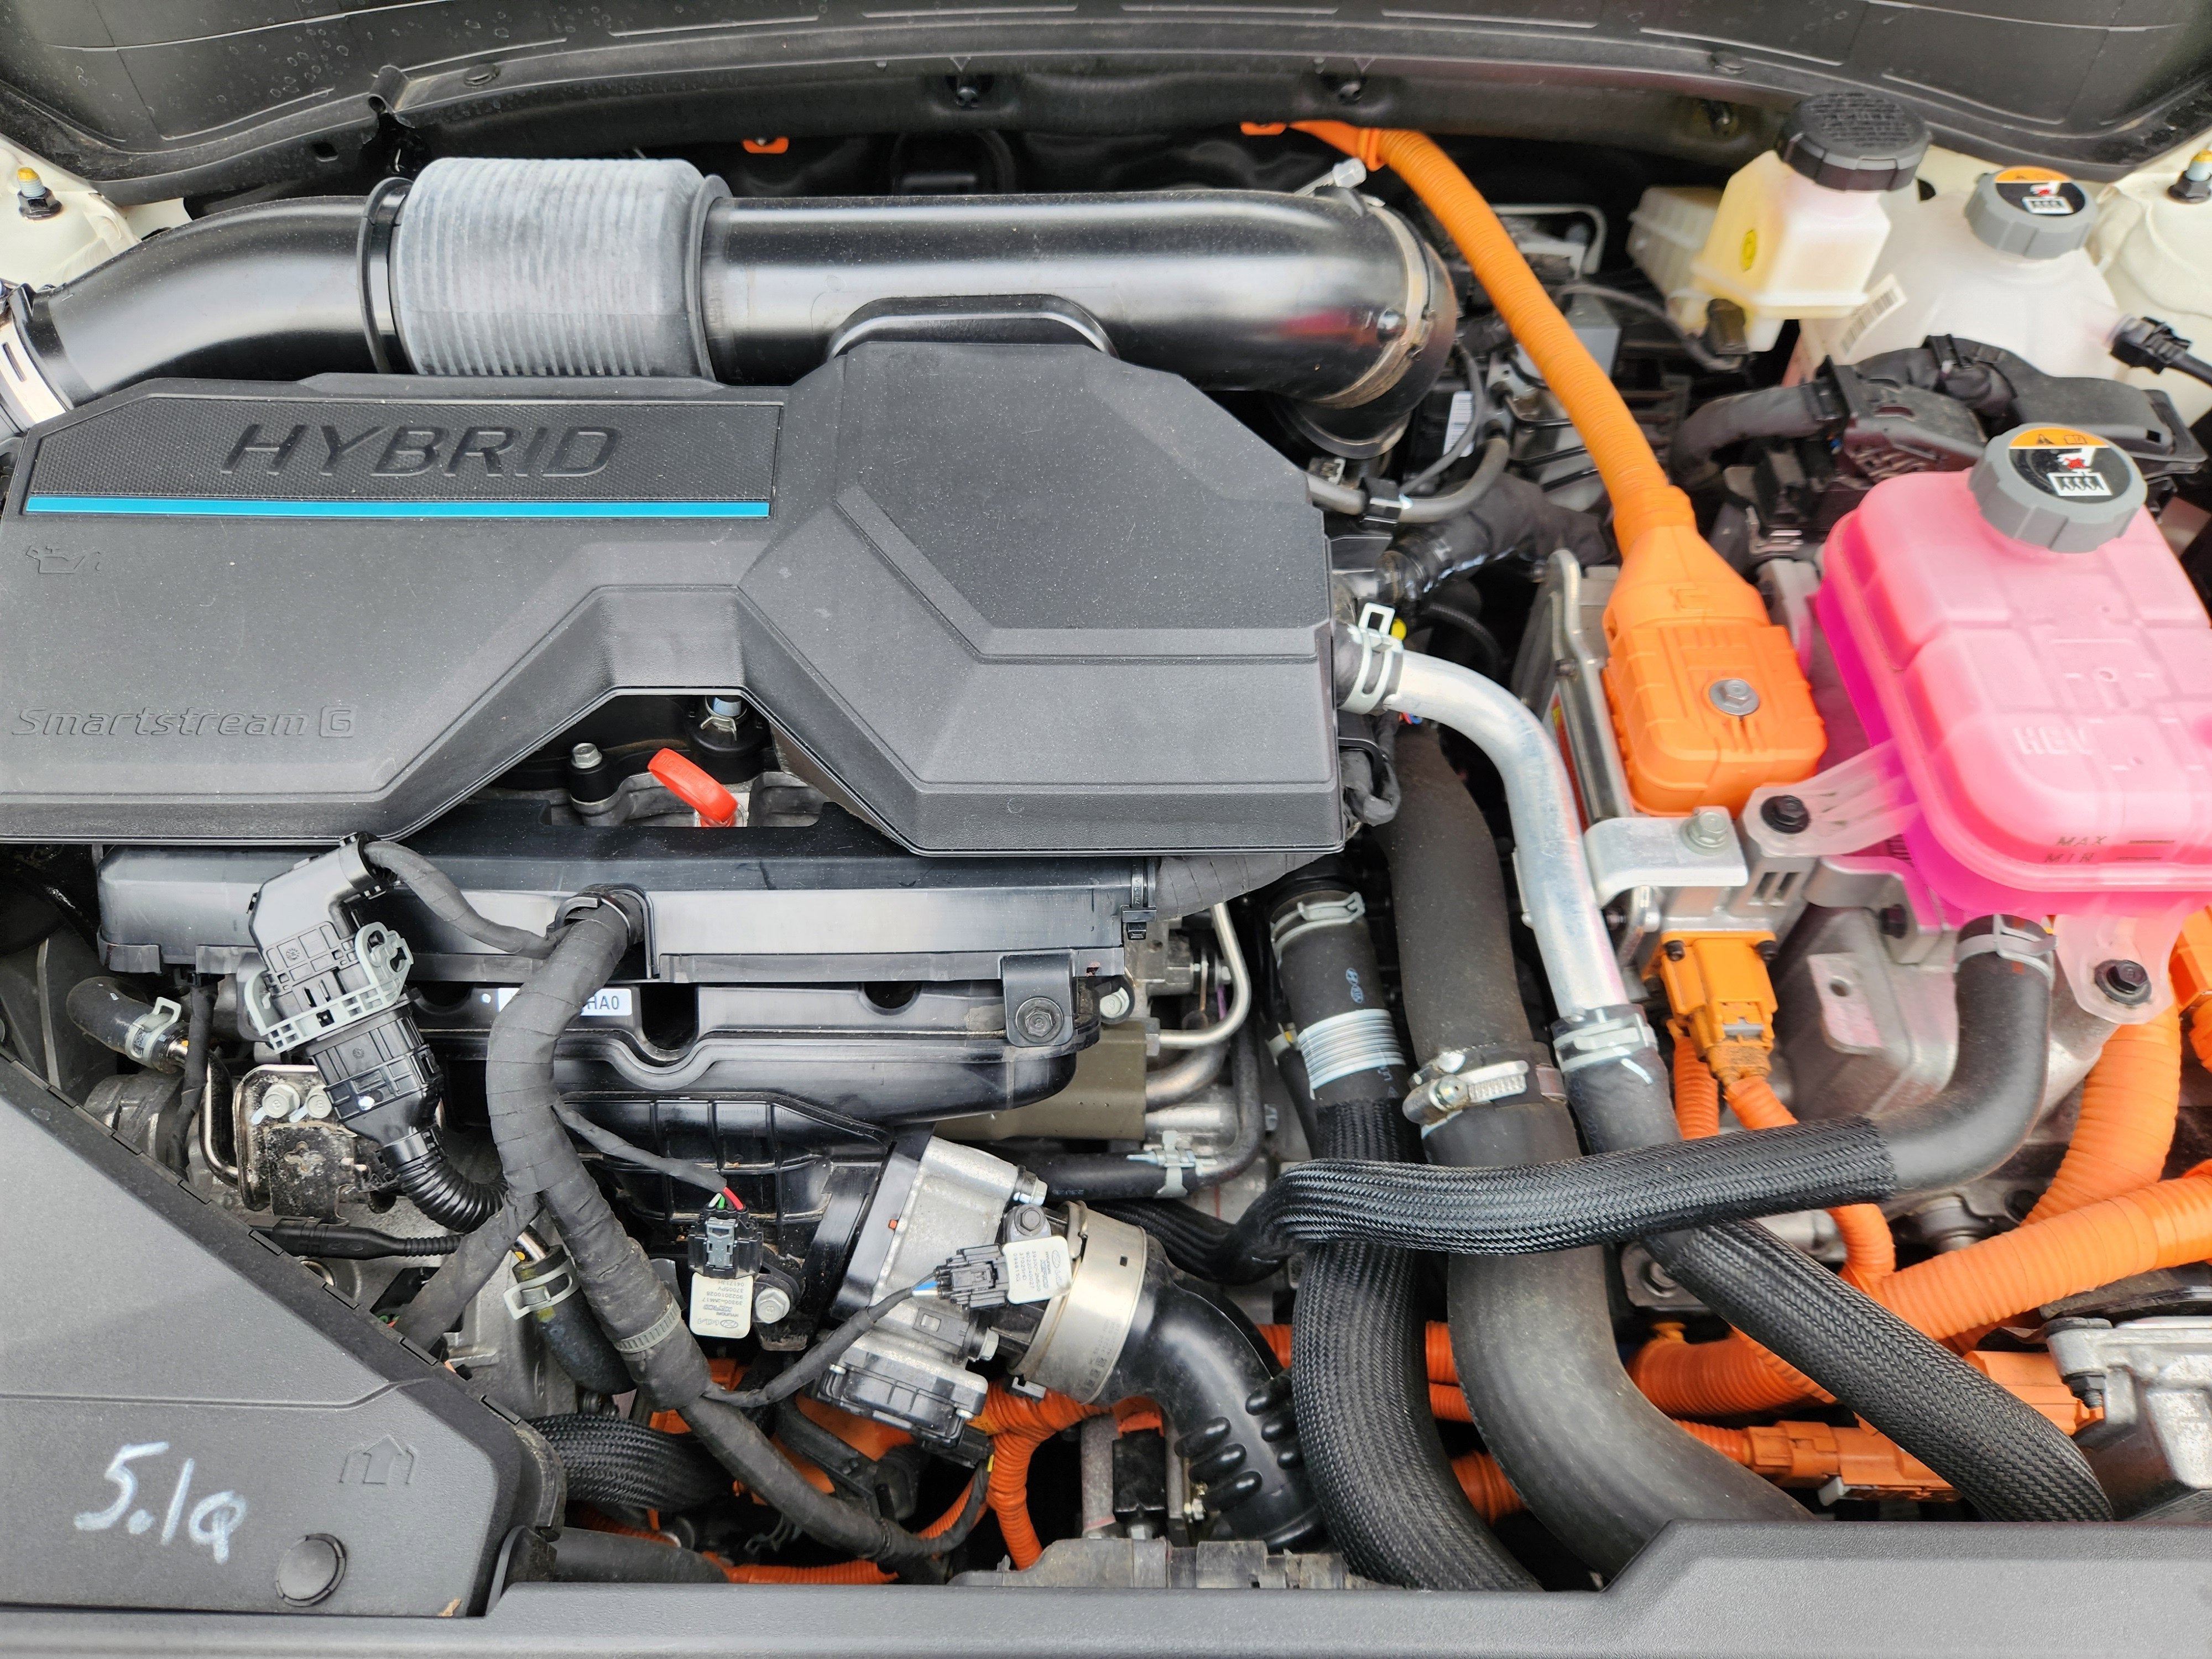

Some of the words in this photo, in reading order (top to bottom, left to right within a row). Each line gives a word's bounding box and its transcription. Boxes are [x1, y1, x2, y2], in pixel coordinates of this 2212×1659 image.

[221, 423, 623, 478] HYBRID
[11, 705, 310, 736] Smartstream
[2057, 836, 2107, 846] MAX
[2044, 853, 2094, 863] MIN
